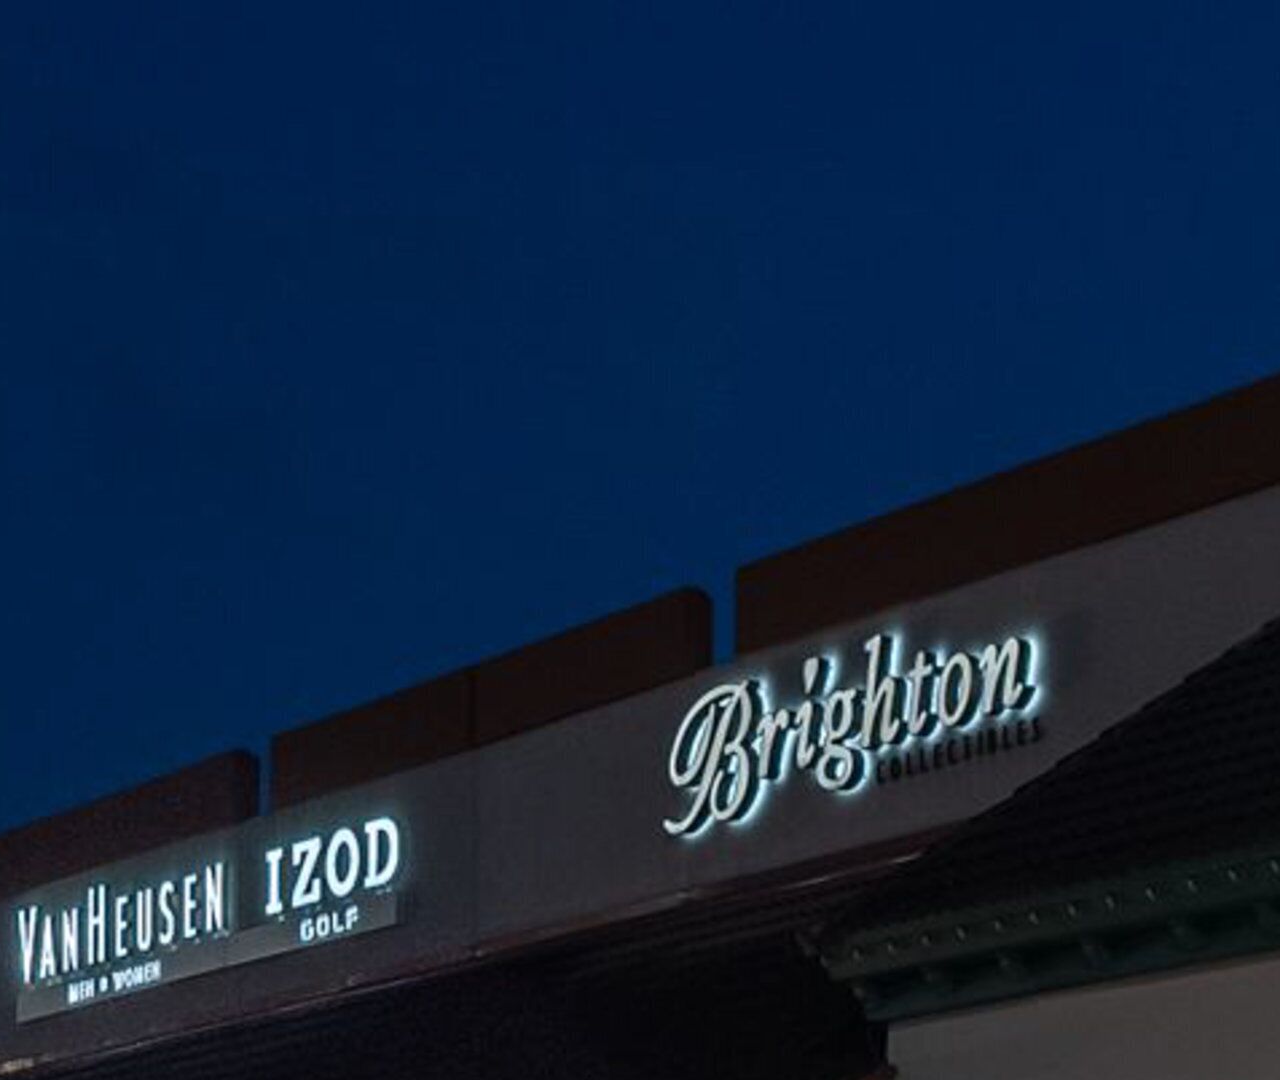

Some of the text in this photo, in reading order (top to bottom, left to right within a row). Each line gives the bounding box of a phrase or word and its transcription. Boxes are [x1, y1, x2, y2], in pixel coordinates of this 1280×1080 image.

[663, 632, 1032, 838] Brighton
[264, 816, 399, 916] IZOD
[300, 904, 359, 943] GOLF
